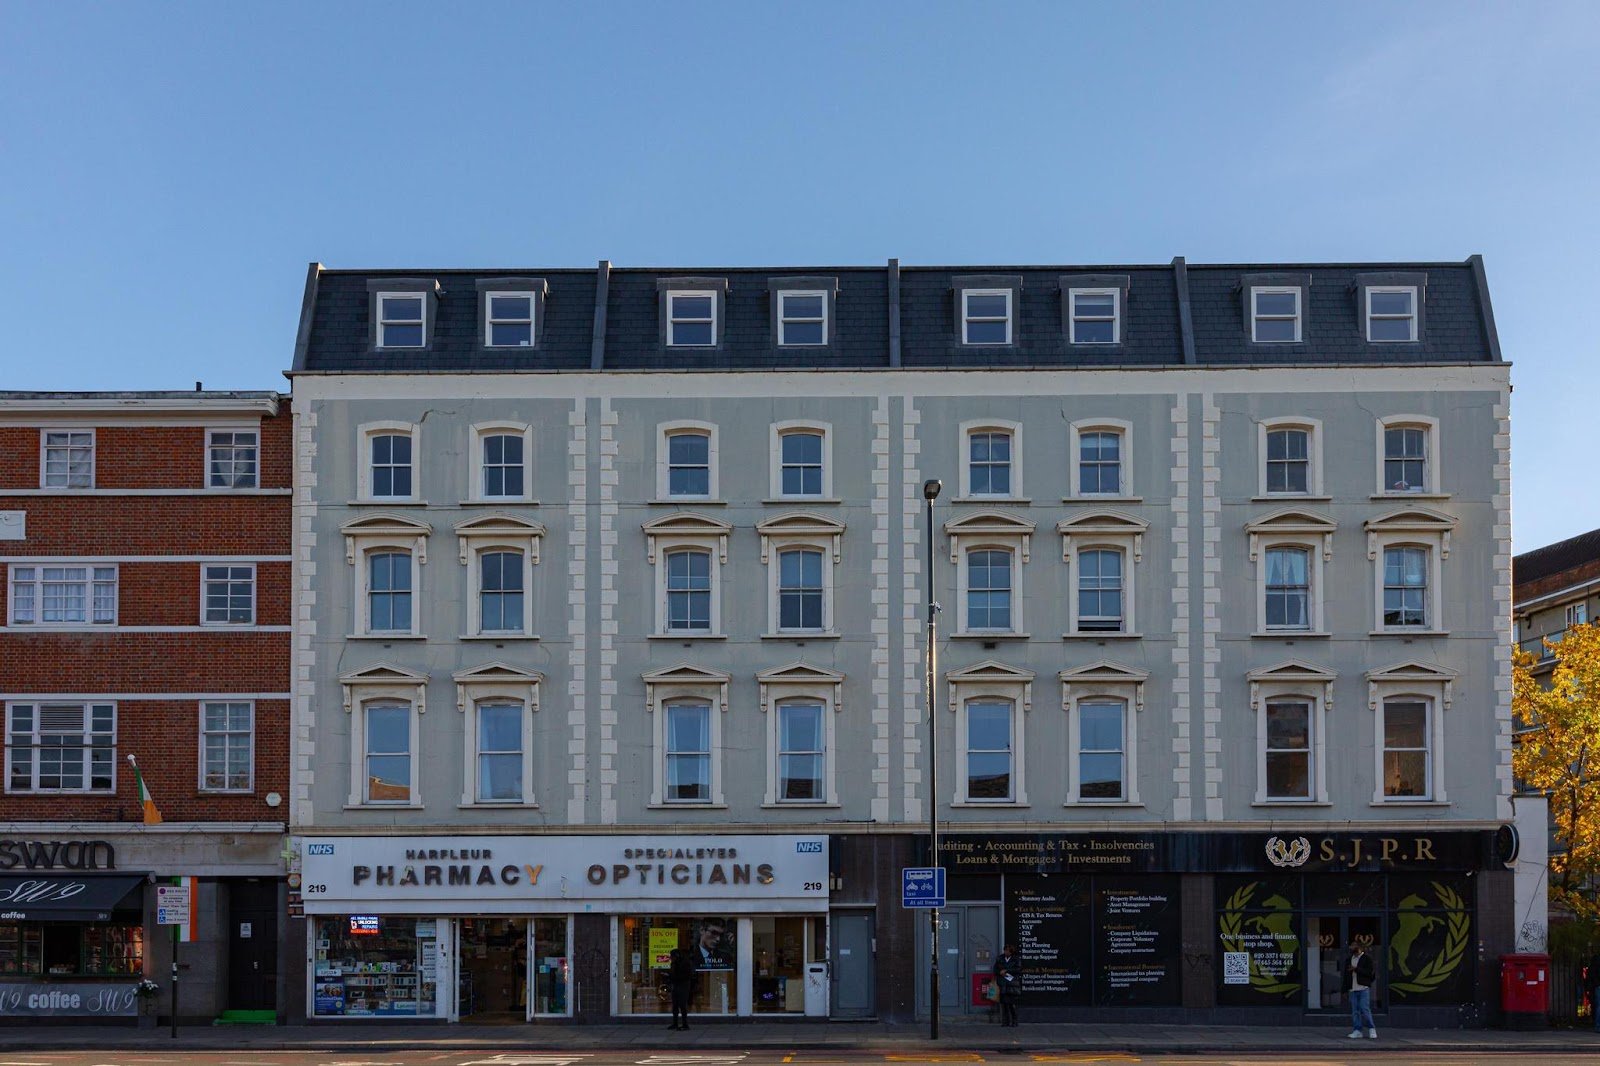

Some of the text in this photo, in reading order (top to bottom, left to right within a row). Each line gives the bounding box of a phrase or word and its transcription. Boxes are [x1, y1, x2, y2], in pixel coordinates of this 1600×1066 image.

[310, 845, 333, 854] NHS
[797, 843, 821, 852] NHS
[928, 840, 1154, 852] uditing Accounting & Tax Insolvencies
[0, 841, 115, 869] swan
[406, 849, 492, 860] HARFLEUR
[624, 848, 737, 859] SPECIALEYES
[956, 853, 1131, 866] Loans & Mortgages Investments
[353, 864, 543, 886] PHARMACY
[587, 864, 775, 885] OPTICIANS
[308, 884, 327, 893] 219
[803, 882, 822, 891] 219
[1, 911, 25, 919] coffee
[28, 991, 81, 1009] coffee
